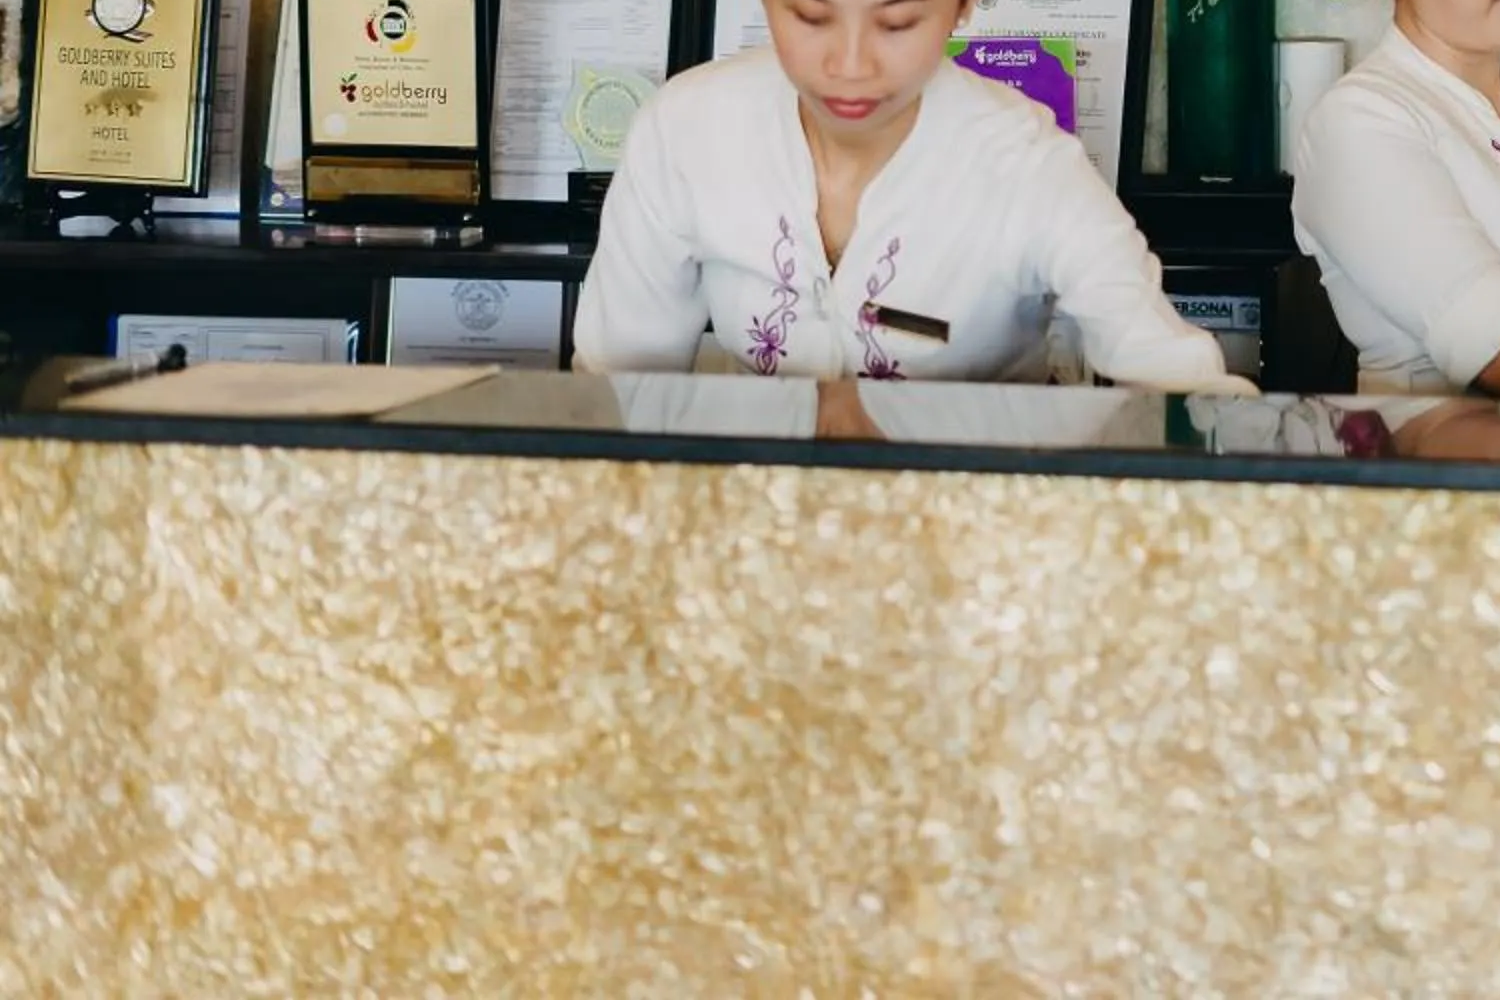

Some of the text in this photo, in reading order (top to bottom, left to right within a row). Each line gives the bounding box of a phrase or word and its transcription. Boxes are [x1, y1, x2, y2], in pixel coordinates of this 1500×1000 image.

[58, 47, 177, 69] GOLDBERRY SUITES
[80, 70, 151, 89] AND HOTEL
[361, 79, 447, 105] goldberry
[92, 127, 129, 141] HOTEL
